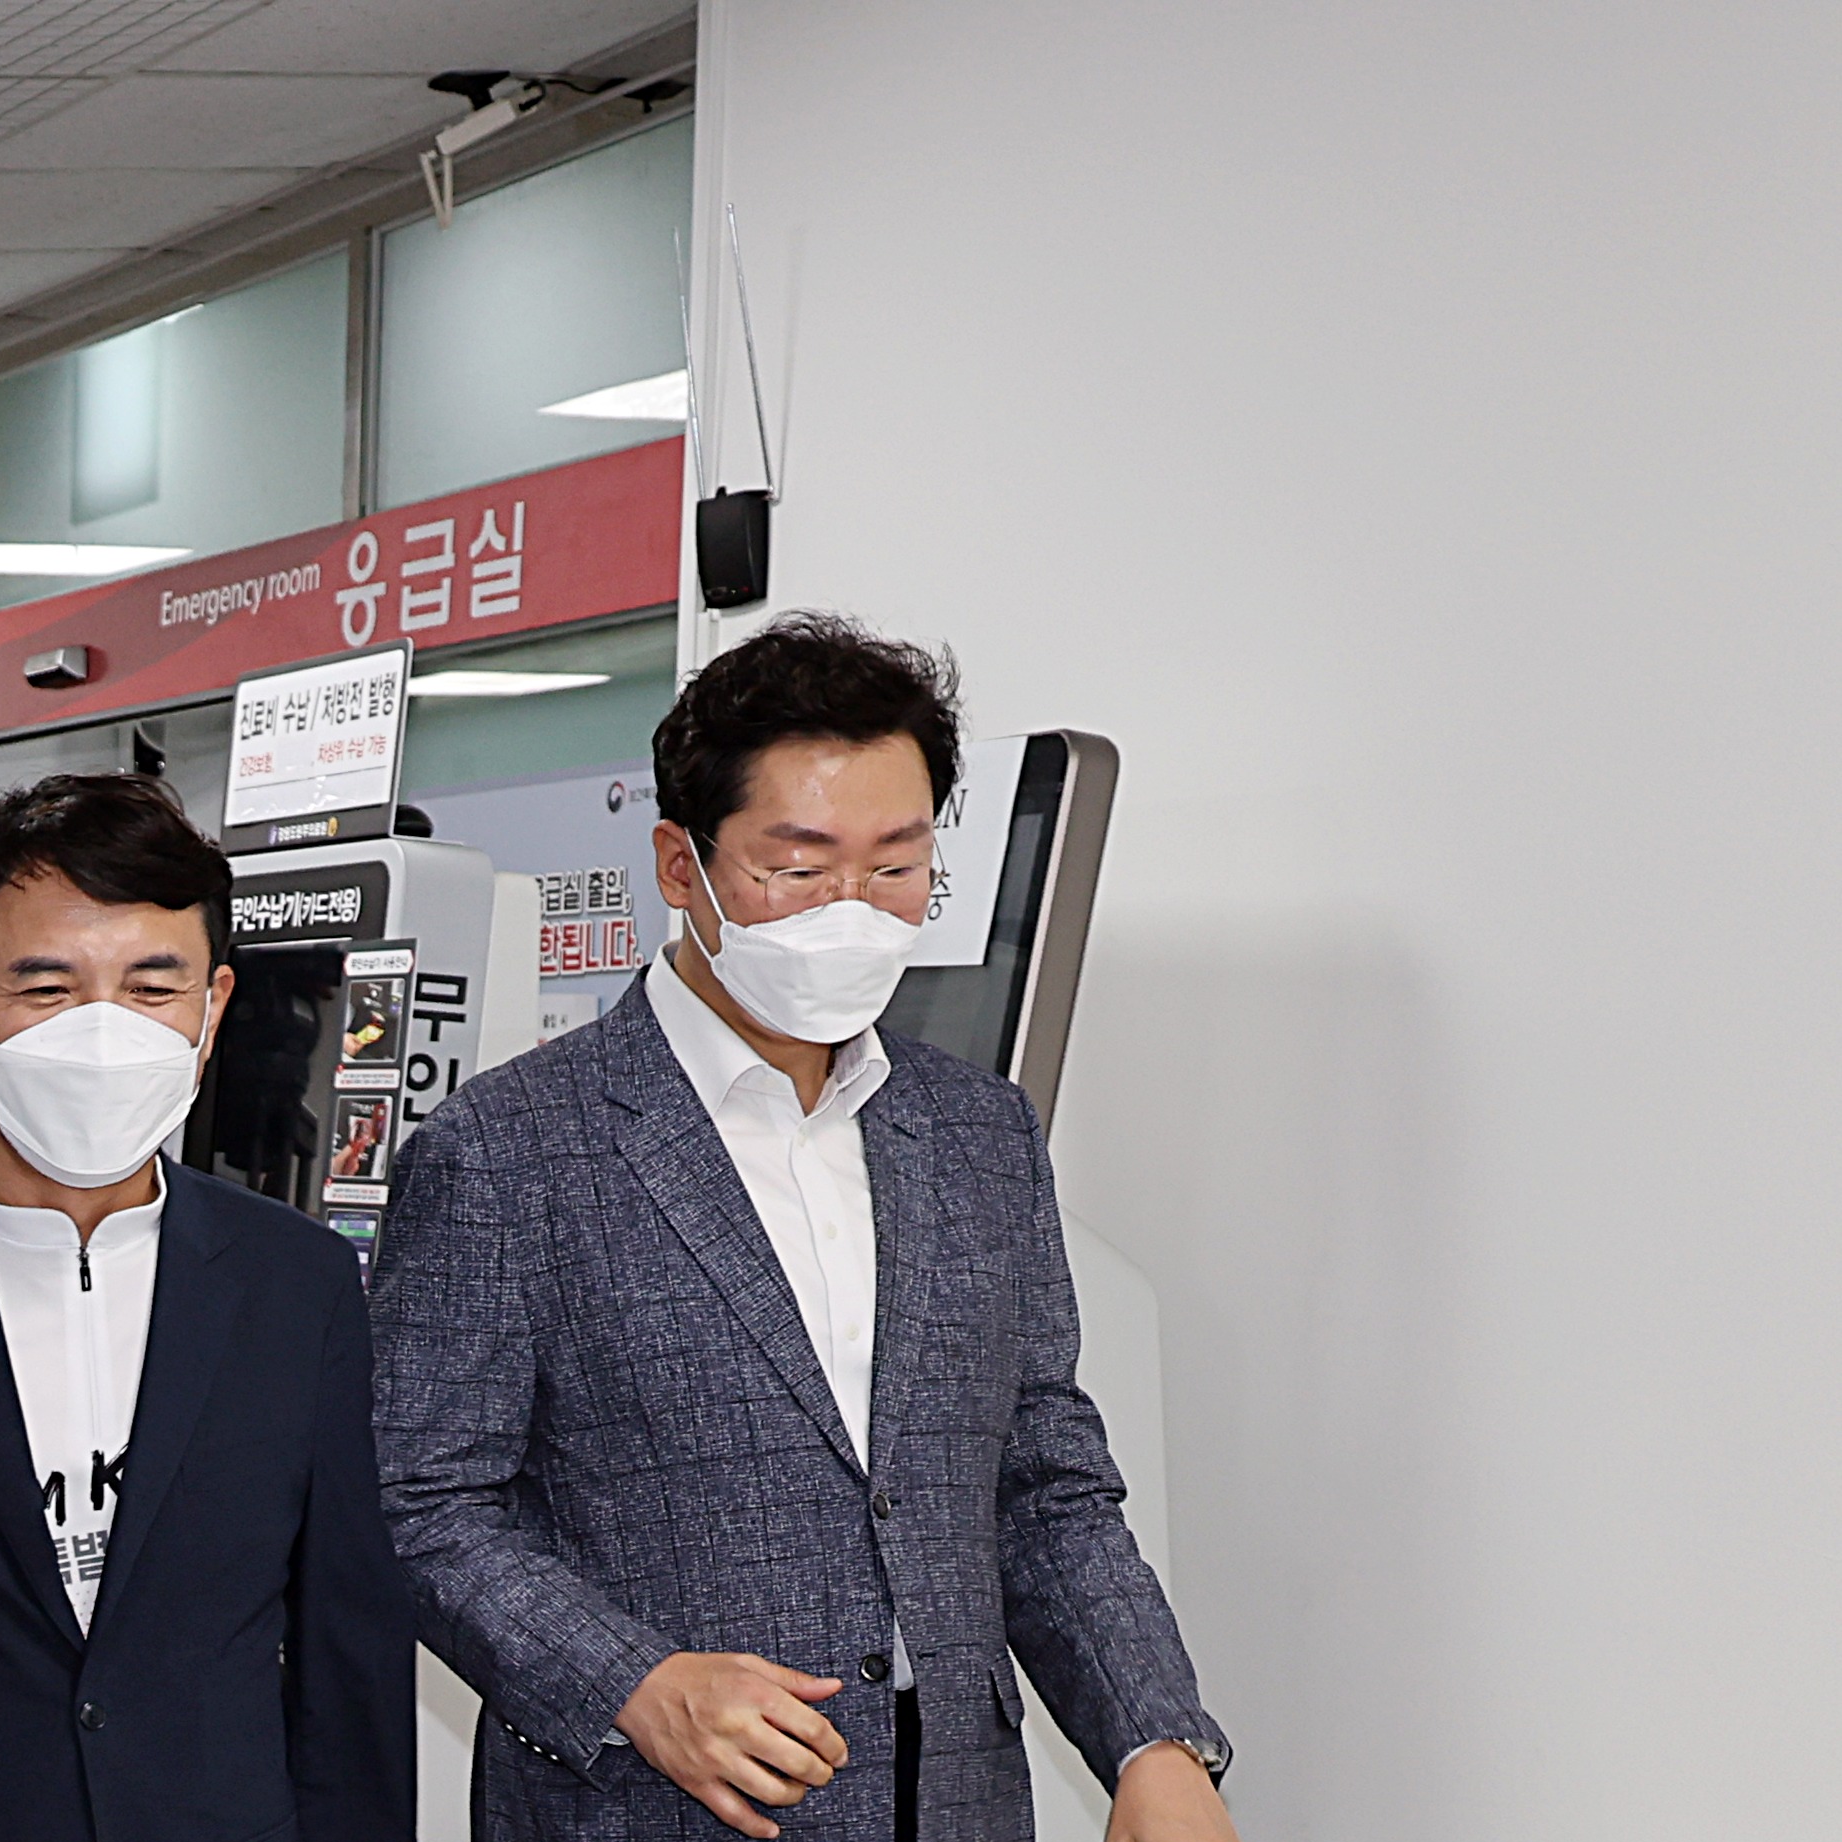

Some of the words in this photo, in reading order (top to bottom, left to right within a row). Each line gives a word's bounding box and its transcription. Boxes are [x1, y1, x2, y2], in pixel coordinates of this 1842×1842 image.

[160, 576, 266, 627] Emergency
[268, 562, 321, 601] room
[335, 501, 526, 647] 응급실
[240, 694, 280, 741] 진료비
[282, 688, 311, 734] 수납
[322, 678, 365, 726] 처방전
[367, 671, 398, 719] 발행
[231, 886, 363, 932] 무인수납기(카드전용)
